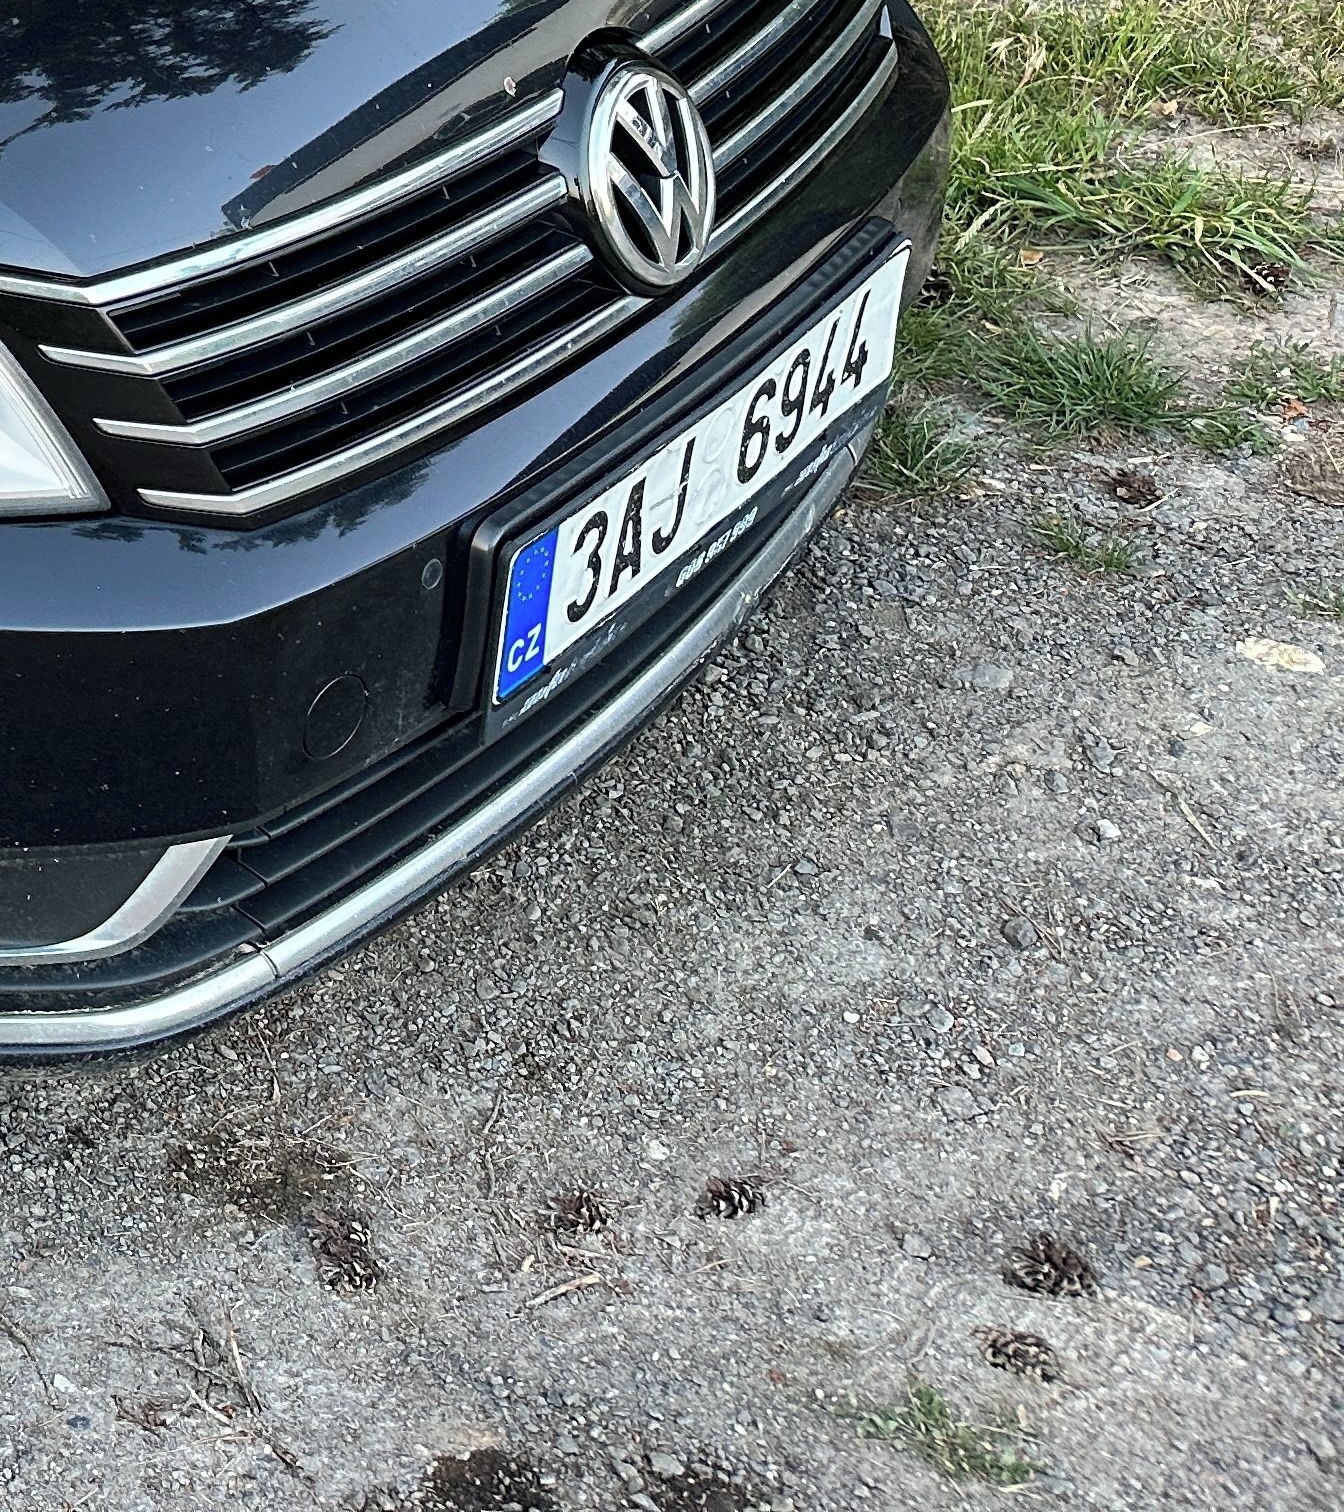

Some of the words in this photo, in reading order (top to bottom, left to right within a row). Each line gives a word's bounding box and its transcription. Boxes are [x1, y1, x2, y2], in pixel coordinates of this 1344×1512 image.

[566, 435, 697, 623] 3AJ
[736, 288, 872, 485] 6944
[507, 622, 542, 673] CZ
